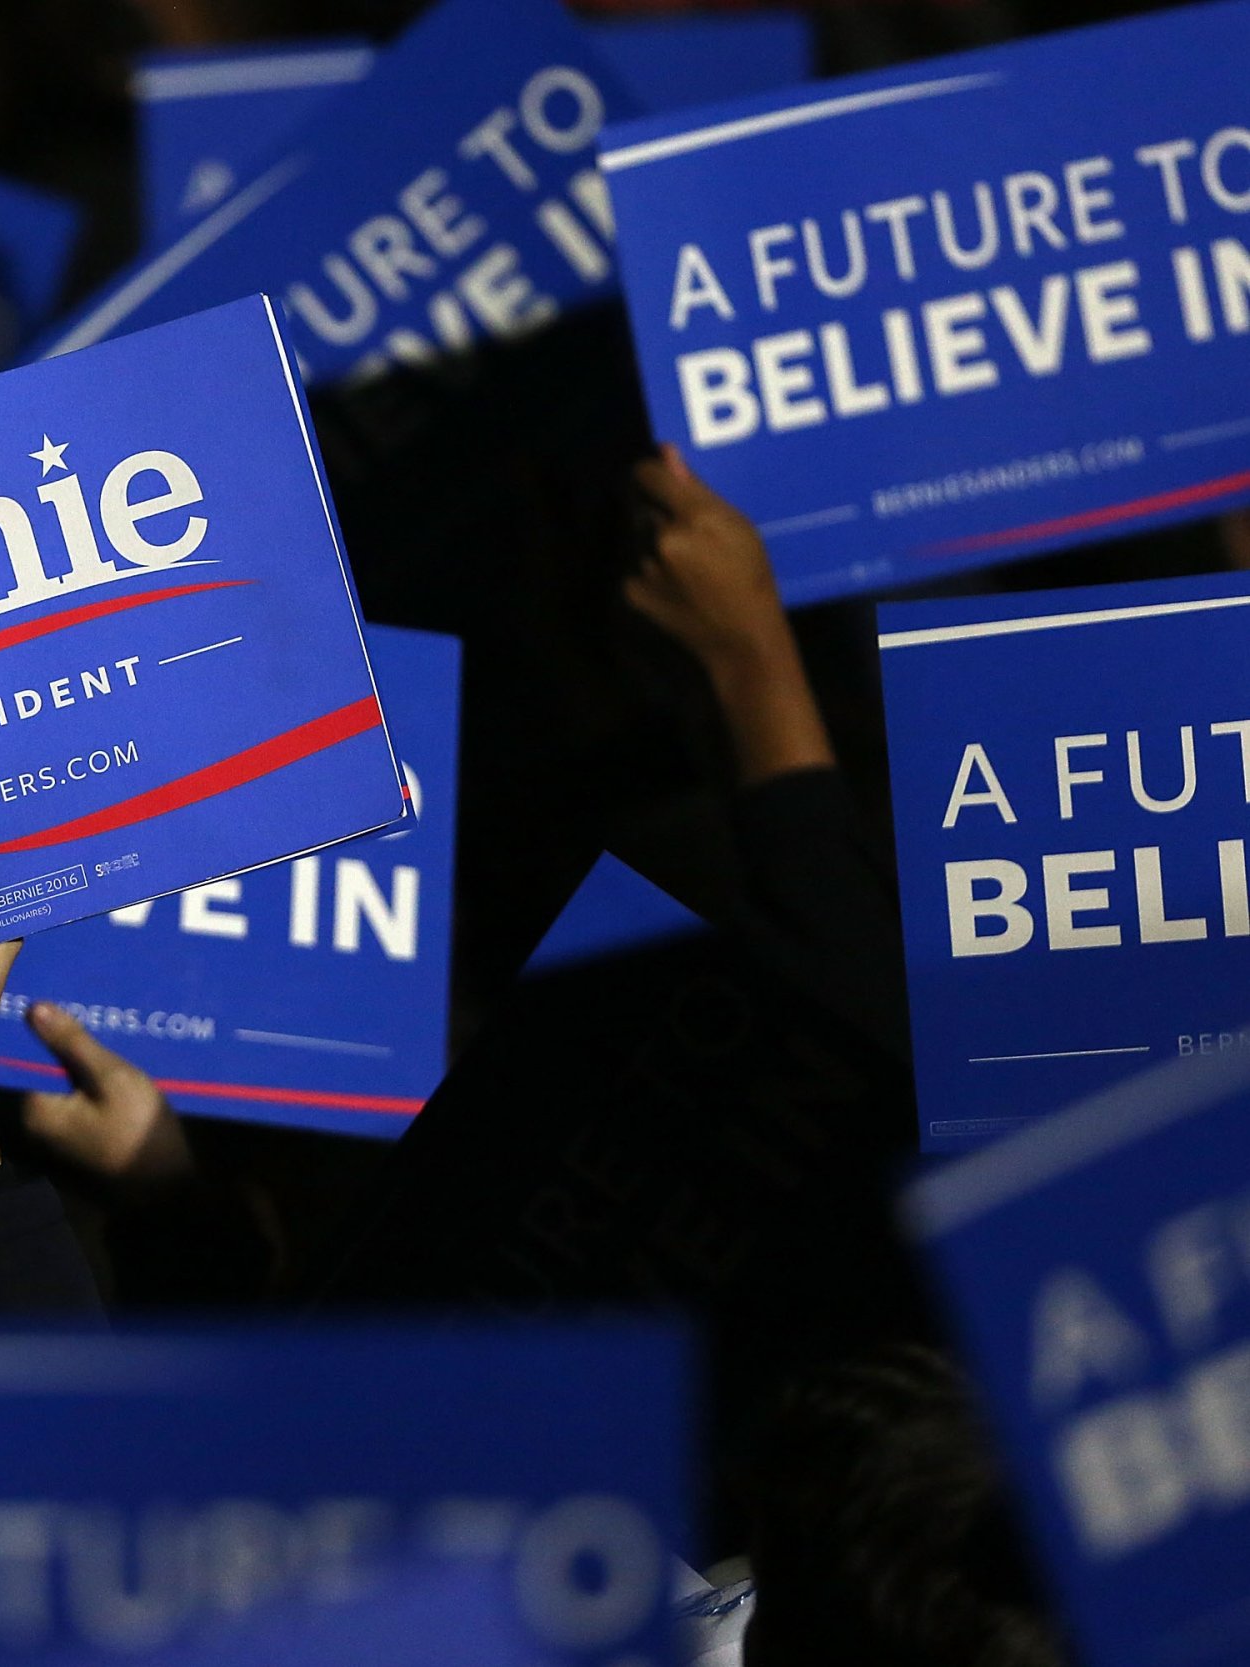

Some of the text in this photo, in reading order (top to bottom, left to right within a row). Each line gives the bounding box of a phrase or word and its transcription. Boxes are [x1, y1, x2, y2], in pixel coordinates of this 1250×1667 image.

[455, 64, 608, 193] TO
[668, 243, 735, 330] A
[748, 155, 1126, 312] FUTURE
[676, 259, 1152, 450] BELIEVE
[941, 742, 1018, 830] A
[46, 872, 79, 893] 2016
[287, 852, 424, 962] IN
[944, 838, 1250, 958] BELI
